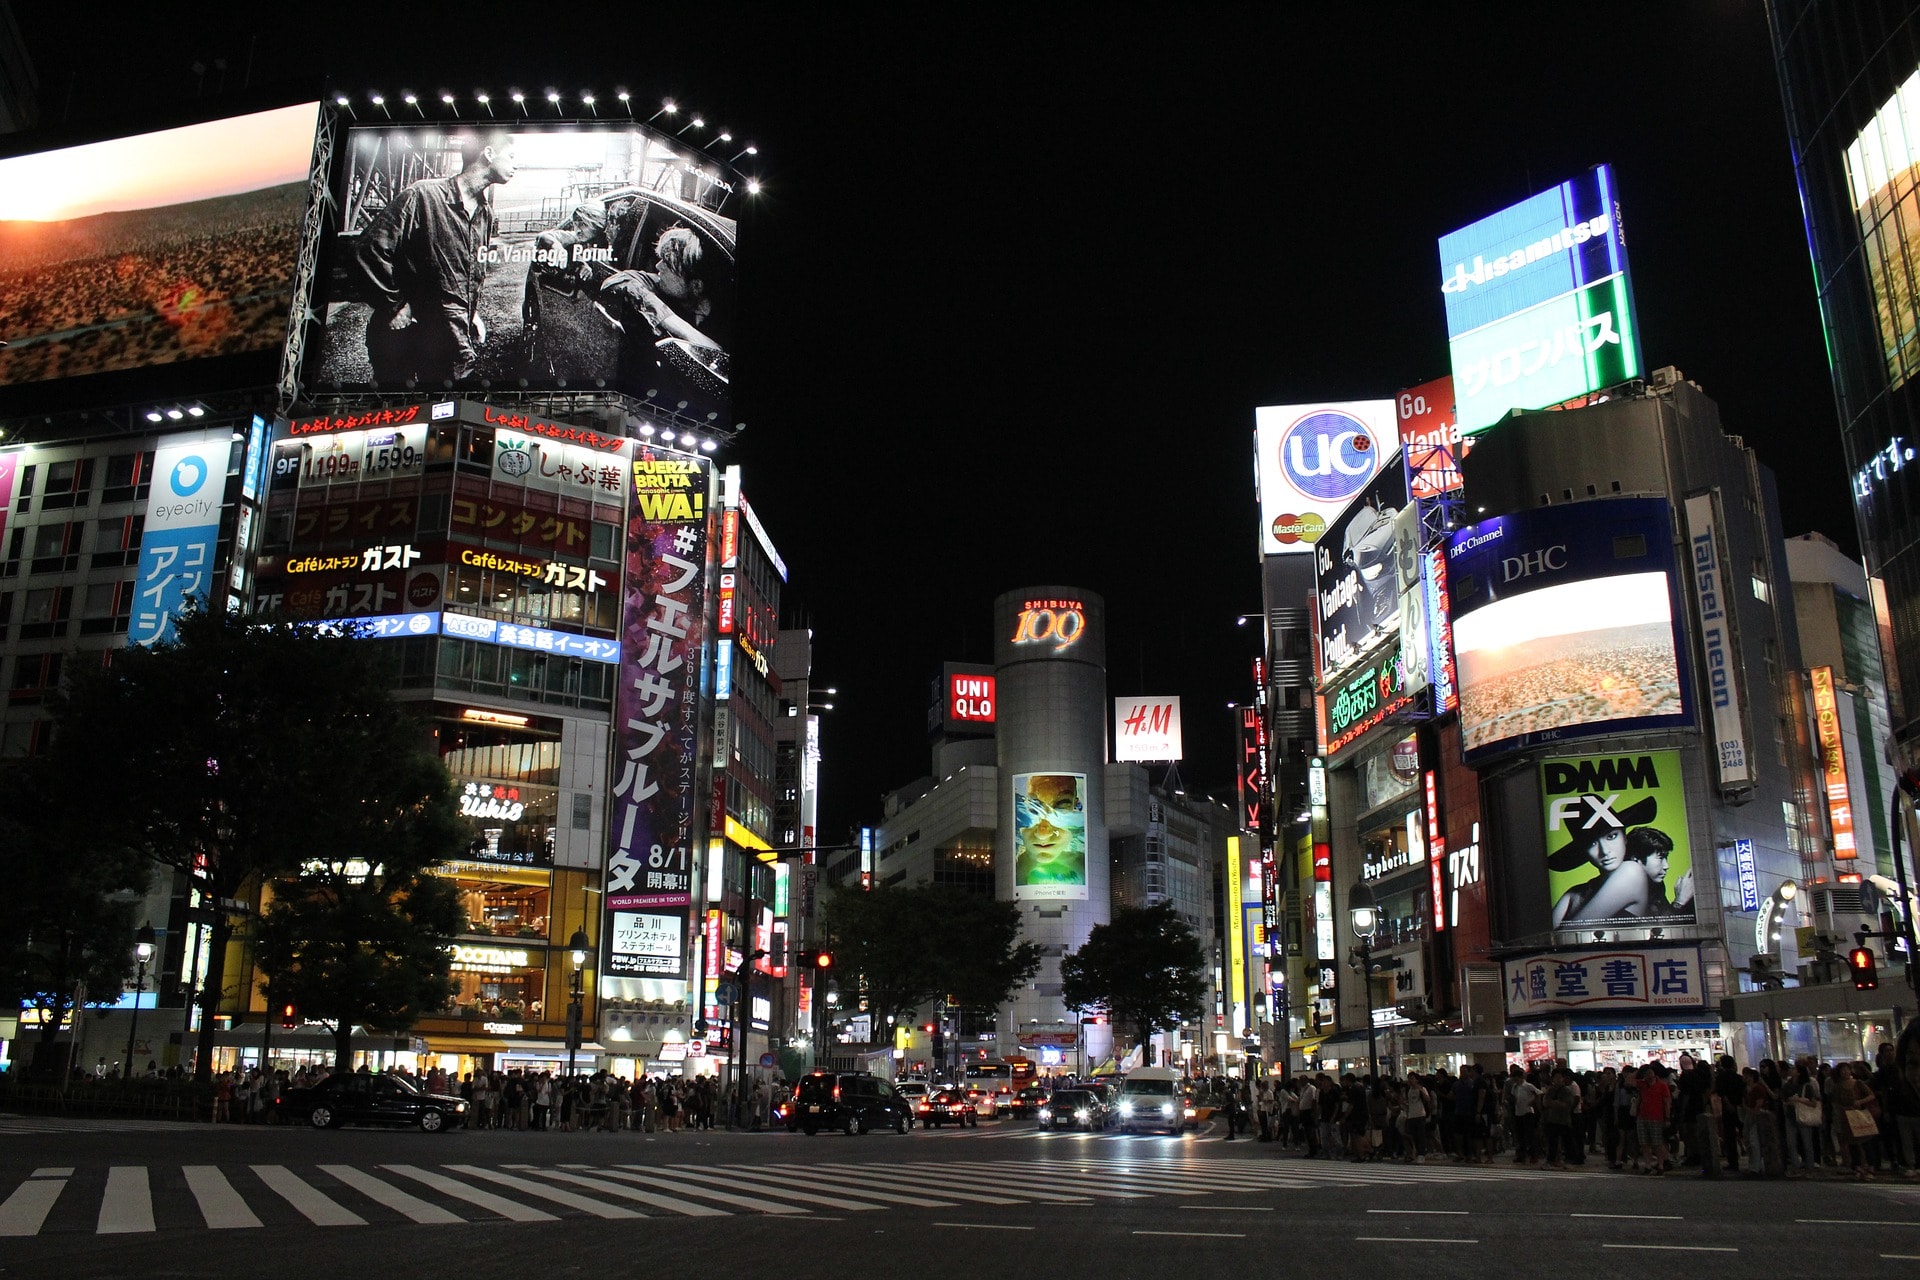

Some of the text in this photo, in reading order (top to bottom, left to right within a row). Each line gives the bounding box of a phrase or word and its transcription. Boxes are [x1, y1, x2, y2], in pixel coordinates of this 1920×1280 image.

[685, 163, 734, 194] HONDA
[477, 244, 618, 268] Go, Vantage Point.
[1441, 213, 1610, 294] Hisamitsu
[1459, 310, 1620, 397] サロンパス
[290, 405, 420, 435] しゃぶしゃぶバイキング
[1400, 393, 1432, 420] Go,
[484, 406, 625, 450] しゃぶしゃぶバイキング
[276, 457, 299, 475] 9F
[365, 446, 423, 475] 1,599円
[540, 451, 621, 491] しゃぶ葉
[633, 460, 702, 475] FUERZA
[634, 474, 692, 488] BRUTA
[156, 498, 214, 520] eyecity
[298, 503, 412, 536] プライス
[638, 493, 703, 520] WA!
[453, 500, 586, 546] コンタクト
[1273, 521, 1325, 534] MasterCard
[1450, 527, 1503, 559] DHC Channel
[361, 544, 421, 573] ガスト
[1318, 546, 1333, 576] Go,
[1502, 544, 1568, 583] DHC
[544, 561, 607, 593] ガスト
[257, 593, 284, 613] 7F
[324, 582, 397, 615] ガスト
[721, 598, 732, 628] ガスト
[1025, 600, 1083, 610] SHIBUYA
[448, 616, 490, 639] AEON
[1011, 608, 1086, 650] 109
[1693, 524, 1729, 708] Taisei neon
[498, 622, 617, 661] 英会話イーオン
[719, 645, 729, 694] イーオン
[955, 679, 988, 697] UNI
[955, 699, 991, 717] QLO
[1123, 704, 1173, 737] H&M
[716, 710, 727, 763] 渋谷駅前ビル
[1541, 729, 1561, 740] DHC
[1720, 749, 1742, 760] 3719
[1722, 758, 1743, 768] 2468
[1815, 671, 1856, 850] クスリのことなら 三千里
[1544, 756, 1660, 795] DMM
[1548, 793, 1624, 831] FX
[648, 844, 686, 871] 8/1
[1363, 848, 1408, 880] Euphoria
[647, 872, 688, 891] 開幕!!
[618, 930, 677, 941] プリンスホテル
[621, 941, 673, 952] ステラボール
[442, 944, 528, 967] OCCITANE
[465, 964, 511, 974] PROVENCE
[1511, 959, 1689, 1004] 大盛堂書店
[1572, 1031, 1615, 1041] 進撃の巨人
[1624, 1030, 1648, 1041] ONE
[1651, 1029, 1693, 1041] PIECE
[1703, 1030, 1721, 1039] 発売
